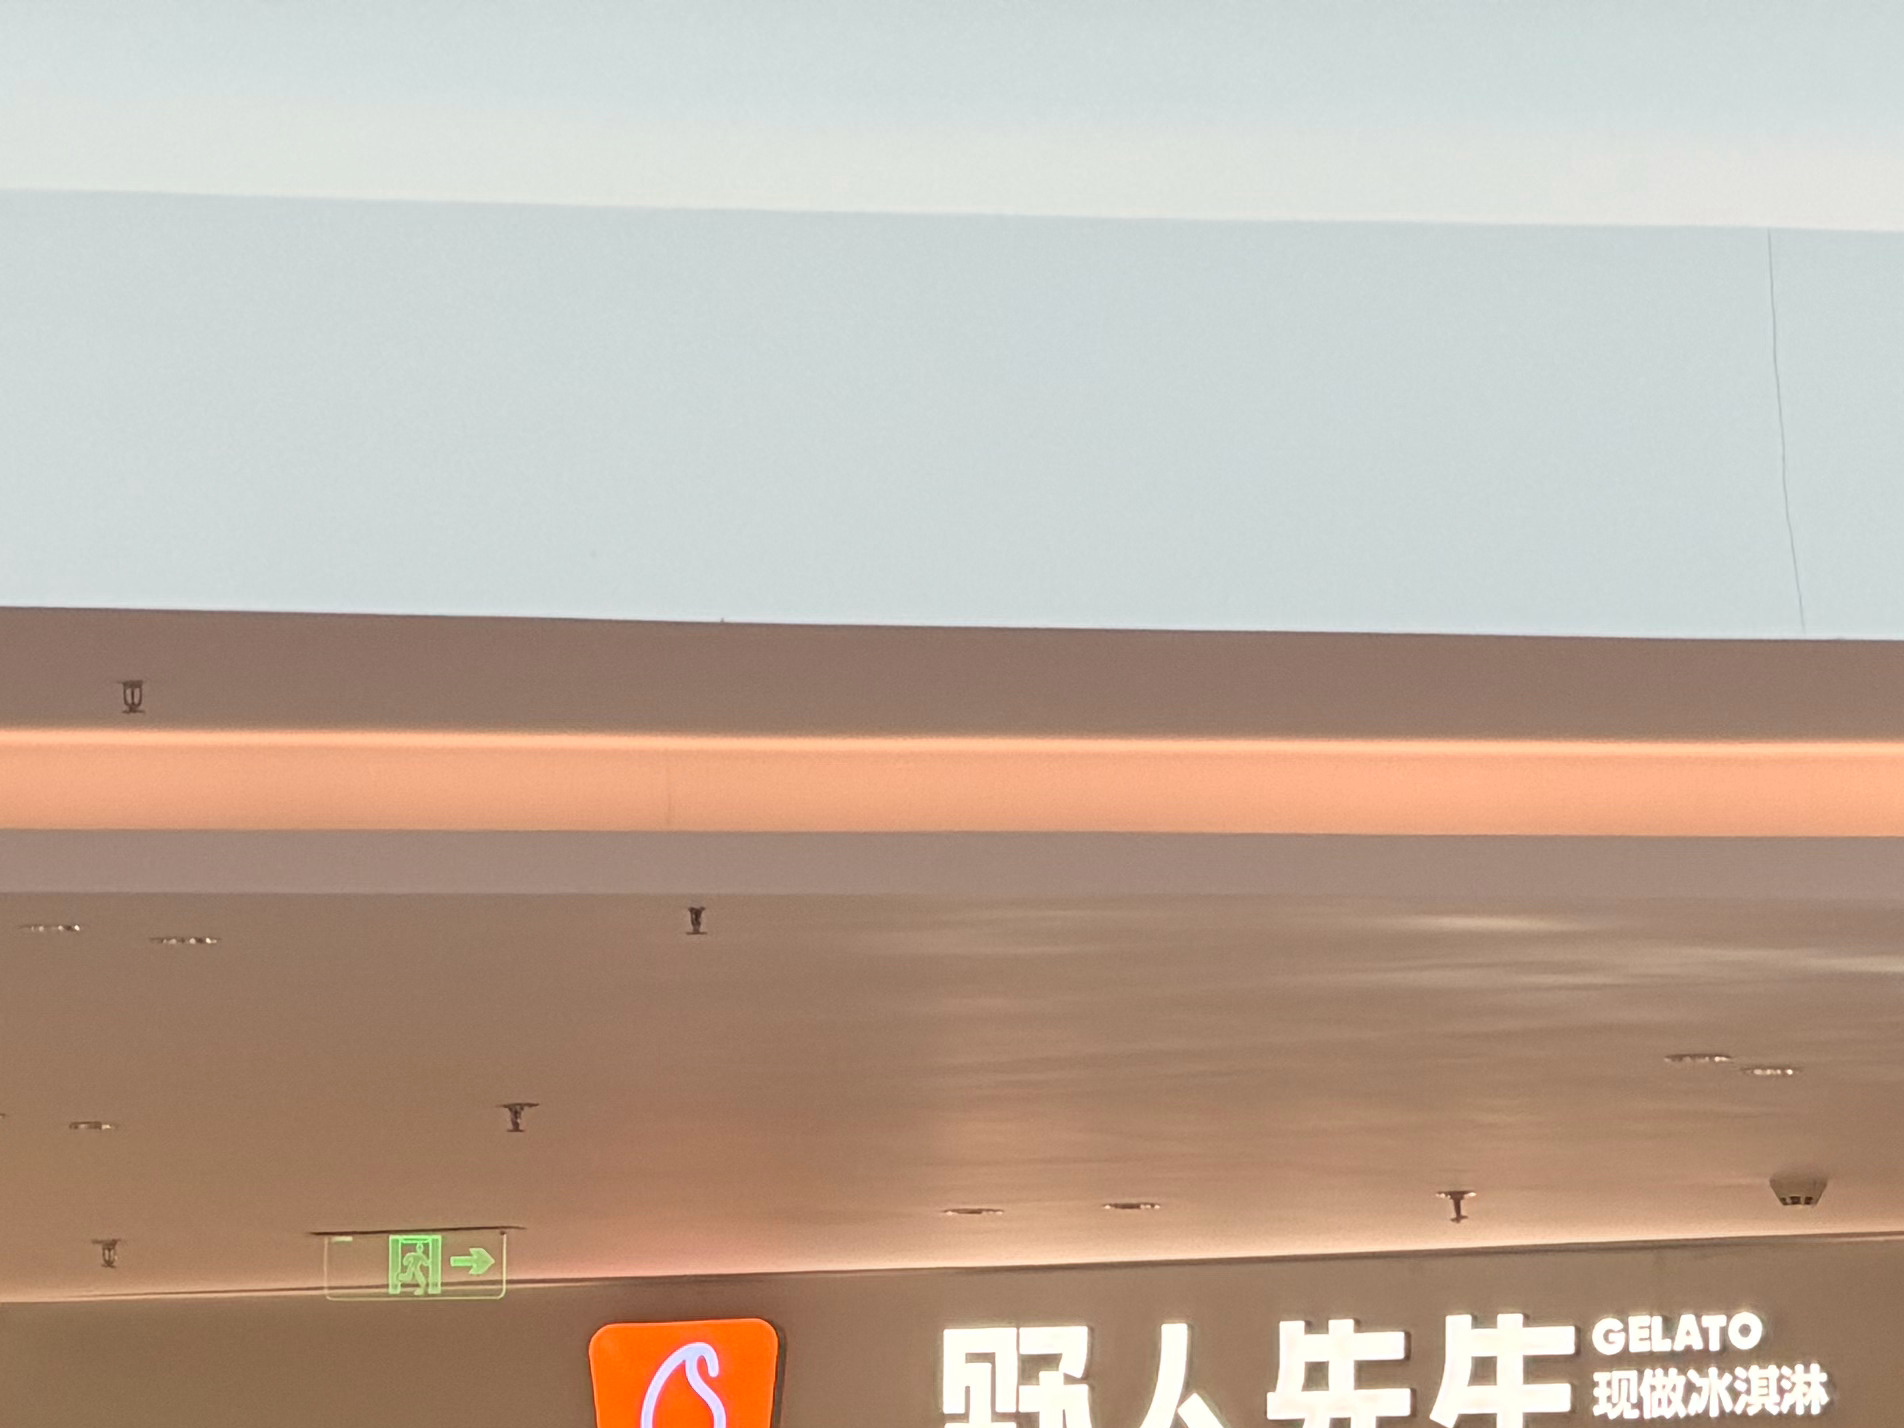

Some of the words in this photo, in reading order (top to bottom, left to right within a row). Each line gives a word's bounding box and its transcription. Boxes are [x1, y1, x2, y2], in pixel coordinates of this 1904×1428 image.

[1592, 1311, 1763, 1355] GELATO
[1592, 1363, 1830, 1420] 现做冰淇淋
